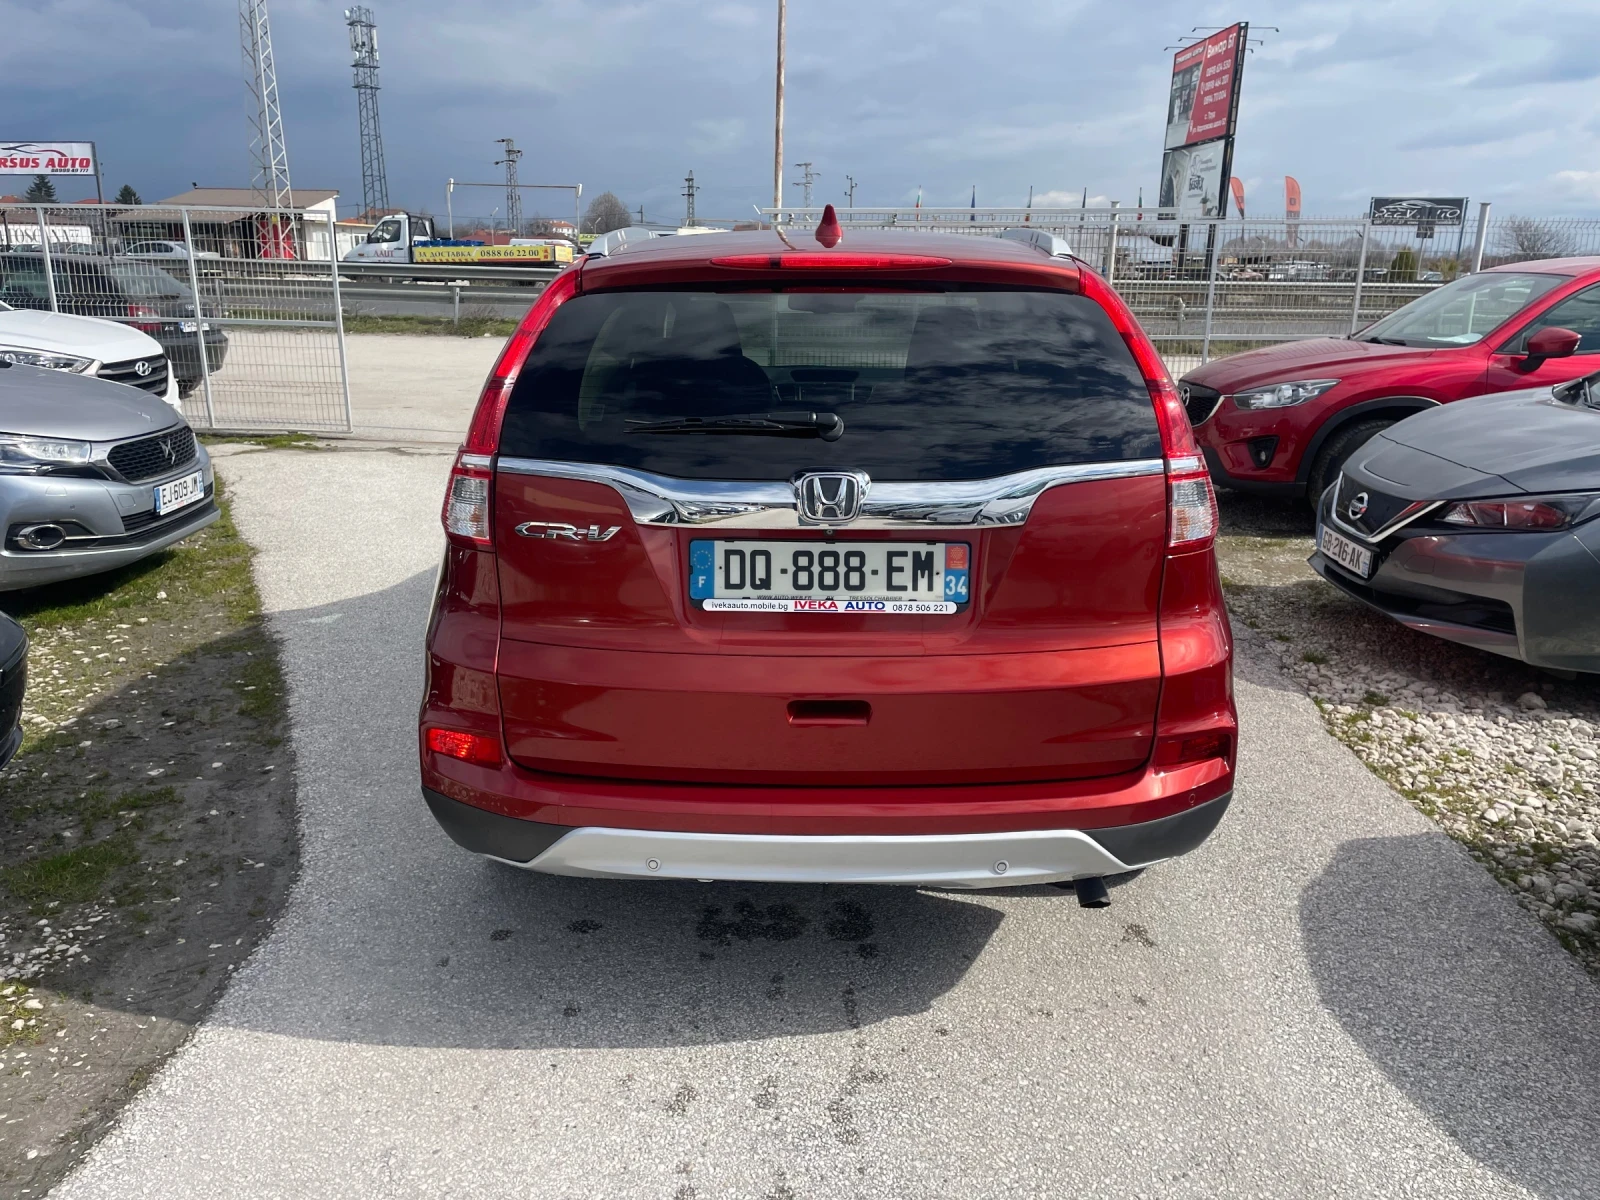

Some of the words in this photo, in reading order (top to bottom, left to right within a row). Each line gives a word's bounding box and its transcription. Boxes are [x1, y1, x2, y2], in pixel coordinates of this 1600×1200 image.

[45, 157, 91, 168] AUTO
[480, 249, 502, 257] 0888
[503, 249, 514, 257] 66
[514, 521, 622, 542] CR-V
[724, 549, 934, 592] DQ-888-EM
[698, 575, 706, 588] F
[945, 575, 968, 595] 34
[711, 601, 788, 611] ivekaauto.mobile.bg
[794, 600, 838, 609] IVEKA
[844, 601, 886, 610] AUTO
[892, 604, 913, 612] 0878
